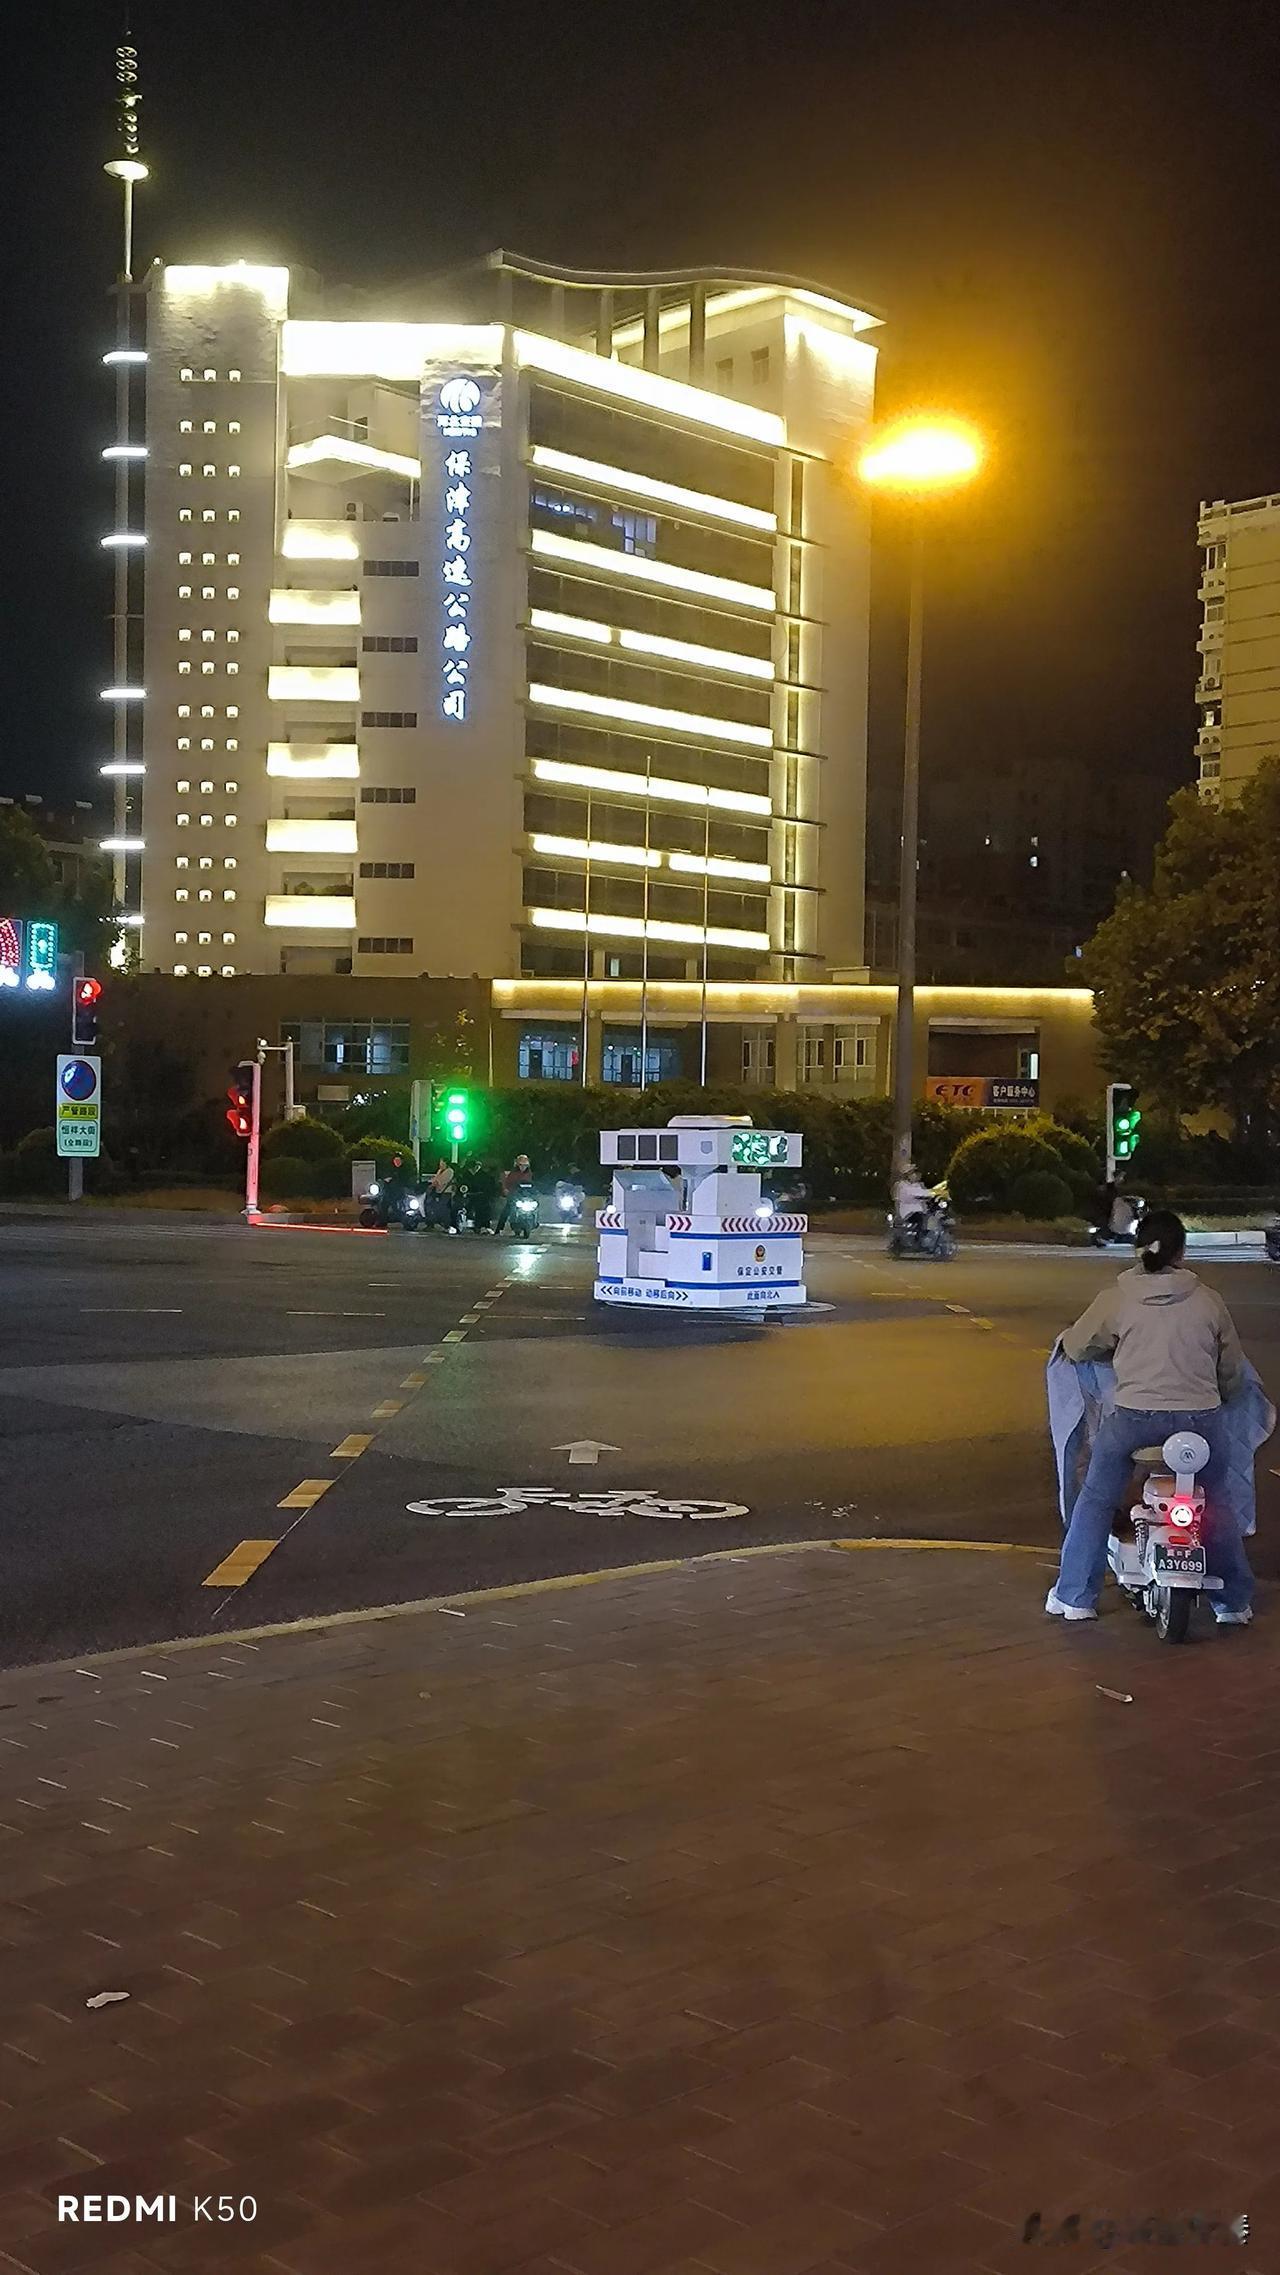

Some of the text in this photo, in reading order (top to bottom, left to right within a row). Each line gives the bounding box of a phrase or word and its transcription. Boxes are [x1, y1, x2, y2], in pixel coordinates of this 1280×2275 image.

[442, 450, 473, 721] 保津高速公路公司
[935, 1084, 975, 1097] ETC
[992, 1085, 1036, 1098] 客户服务中心
[61, 1125, 96, 1135] 恒祥大街
[1158, 1559, 1203, 1571] A3Y699
